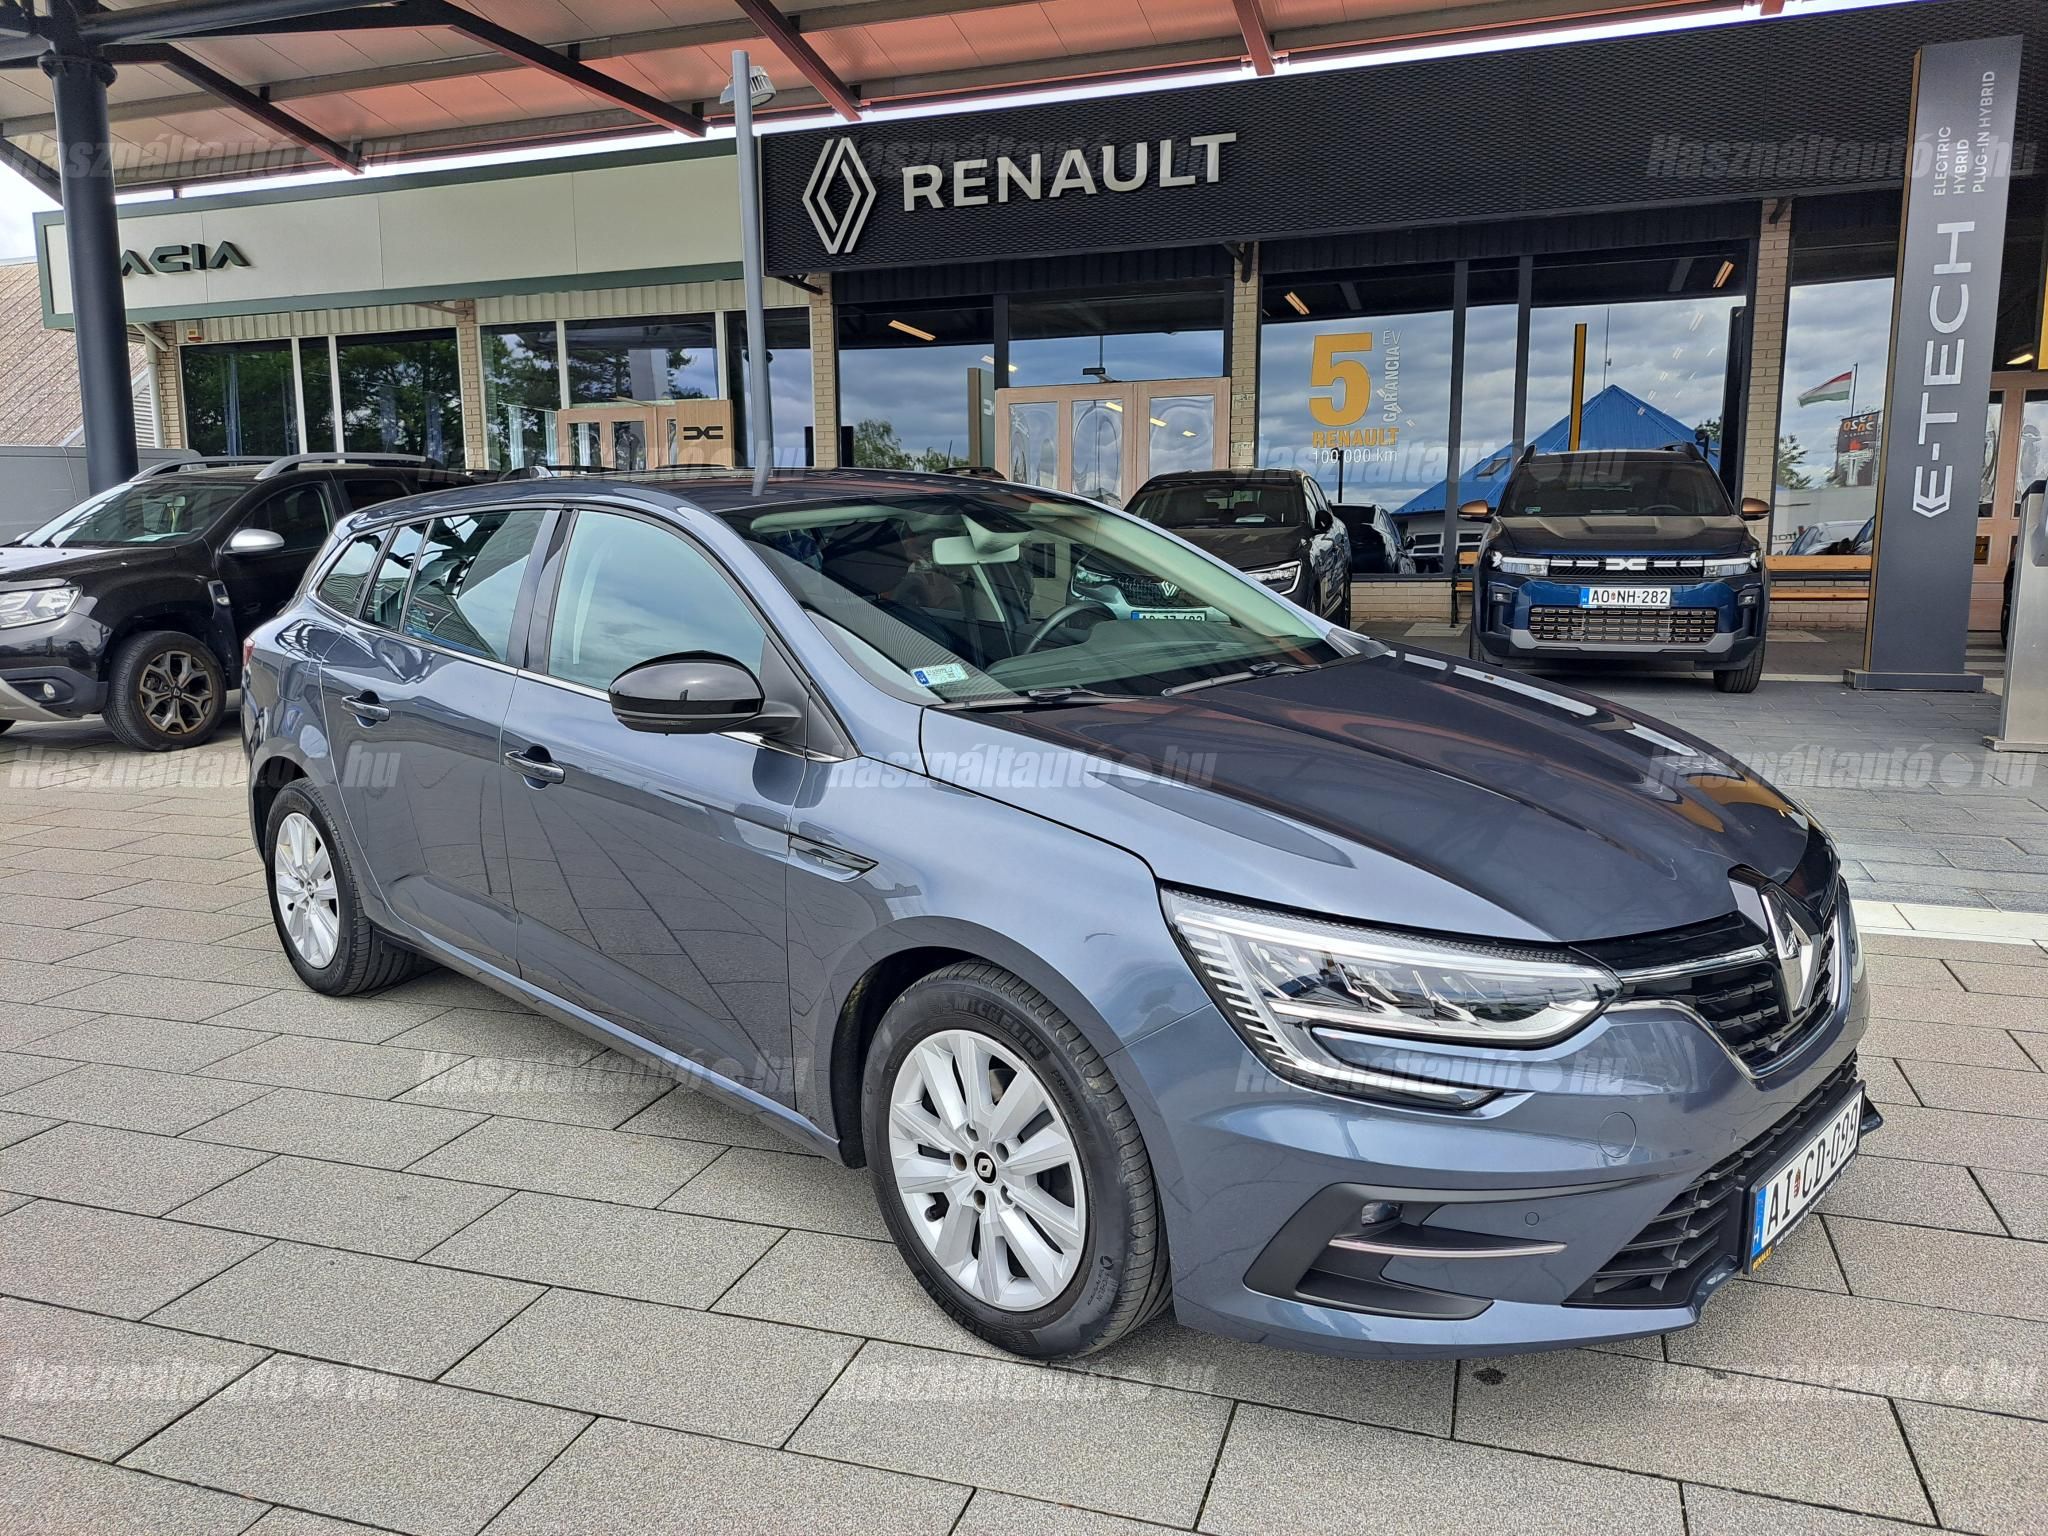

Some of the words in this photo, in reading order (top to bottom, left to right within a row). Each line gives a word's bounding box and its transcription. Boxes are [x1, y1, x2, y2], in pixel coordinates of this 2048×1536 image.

[1978, 71, 1995, 128] HYBRID
[903, 132, 1237, 212] RENAULT
[1933, 126, 1951, 196] ELECTRIC
[1953, 139, 1969, 195] HYBRID
[1972, 131, 1990, 193] PLUG-IN
[120, 239, 250, 277] ACIA
[1309, 331, 1373, 427] 5
[1382, 346, 1401, 423] GARANCIA
[1912, 221, 1976, 519] E-TECH
[1312, 427, 1400, 448] RENAULT
[1591, 590, 1610, 603] AO
[1616, 590, 1668, 604] NH-282
